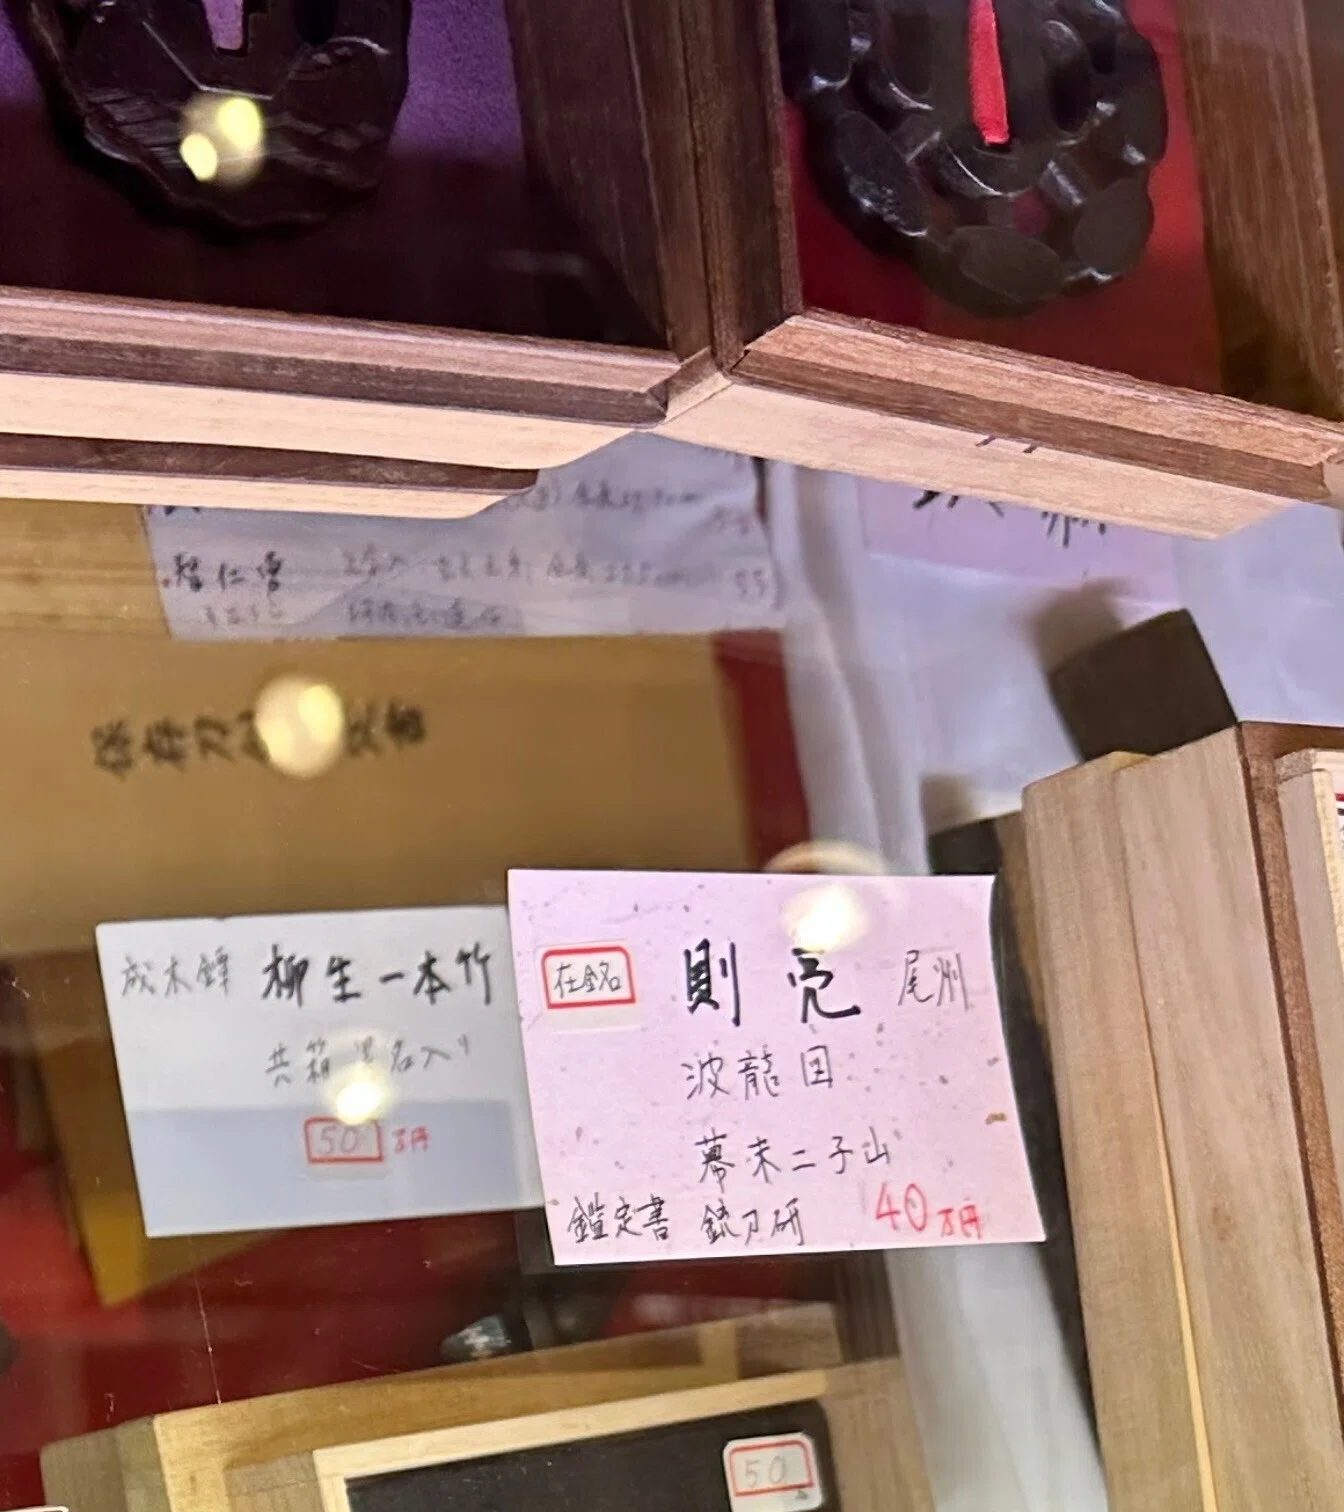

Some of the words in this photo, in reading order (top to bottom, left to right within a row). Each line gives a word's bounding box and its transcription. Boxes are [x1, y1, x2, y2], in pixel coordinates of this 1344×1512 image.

[261, 940, 494, 1009] 柳生一本竹
[552, 961, 623, 1001] 在銘
[693, 1125, 894, 1193] 幕末二子山
[566, 1189, 672, 1246] 鑑定書
[873, 1180, 984, 1241] 40万円
[744, 1454, 789, 1488] 50
